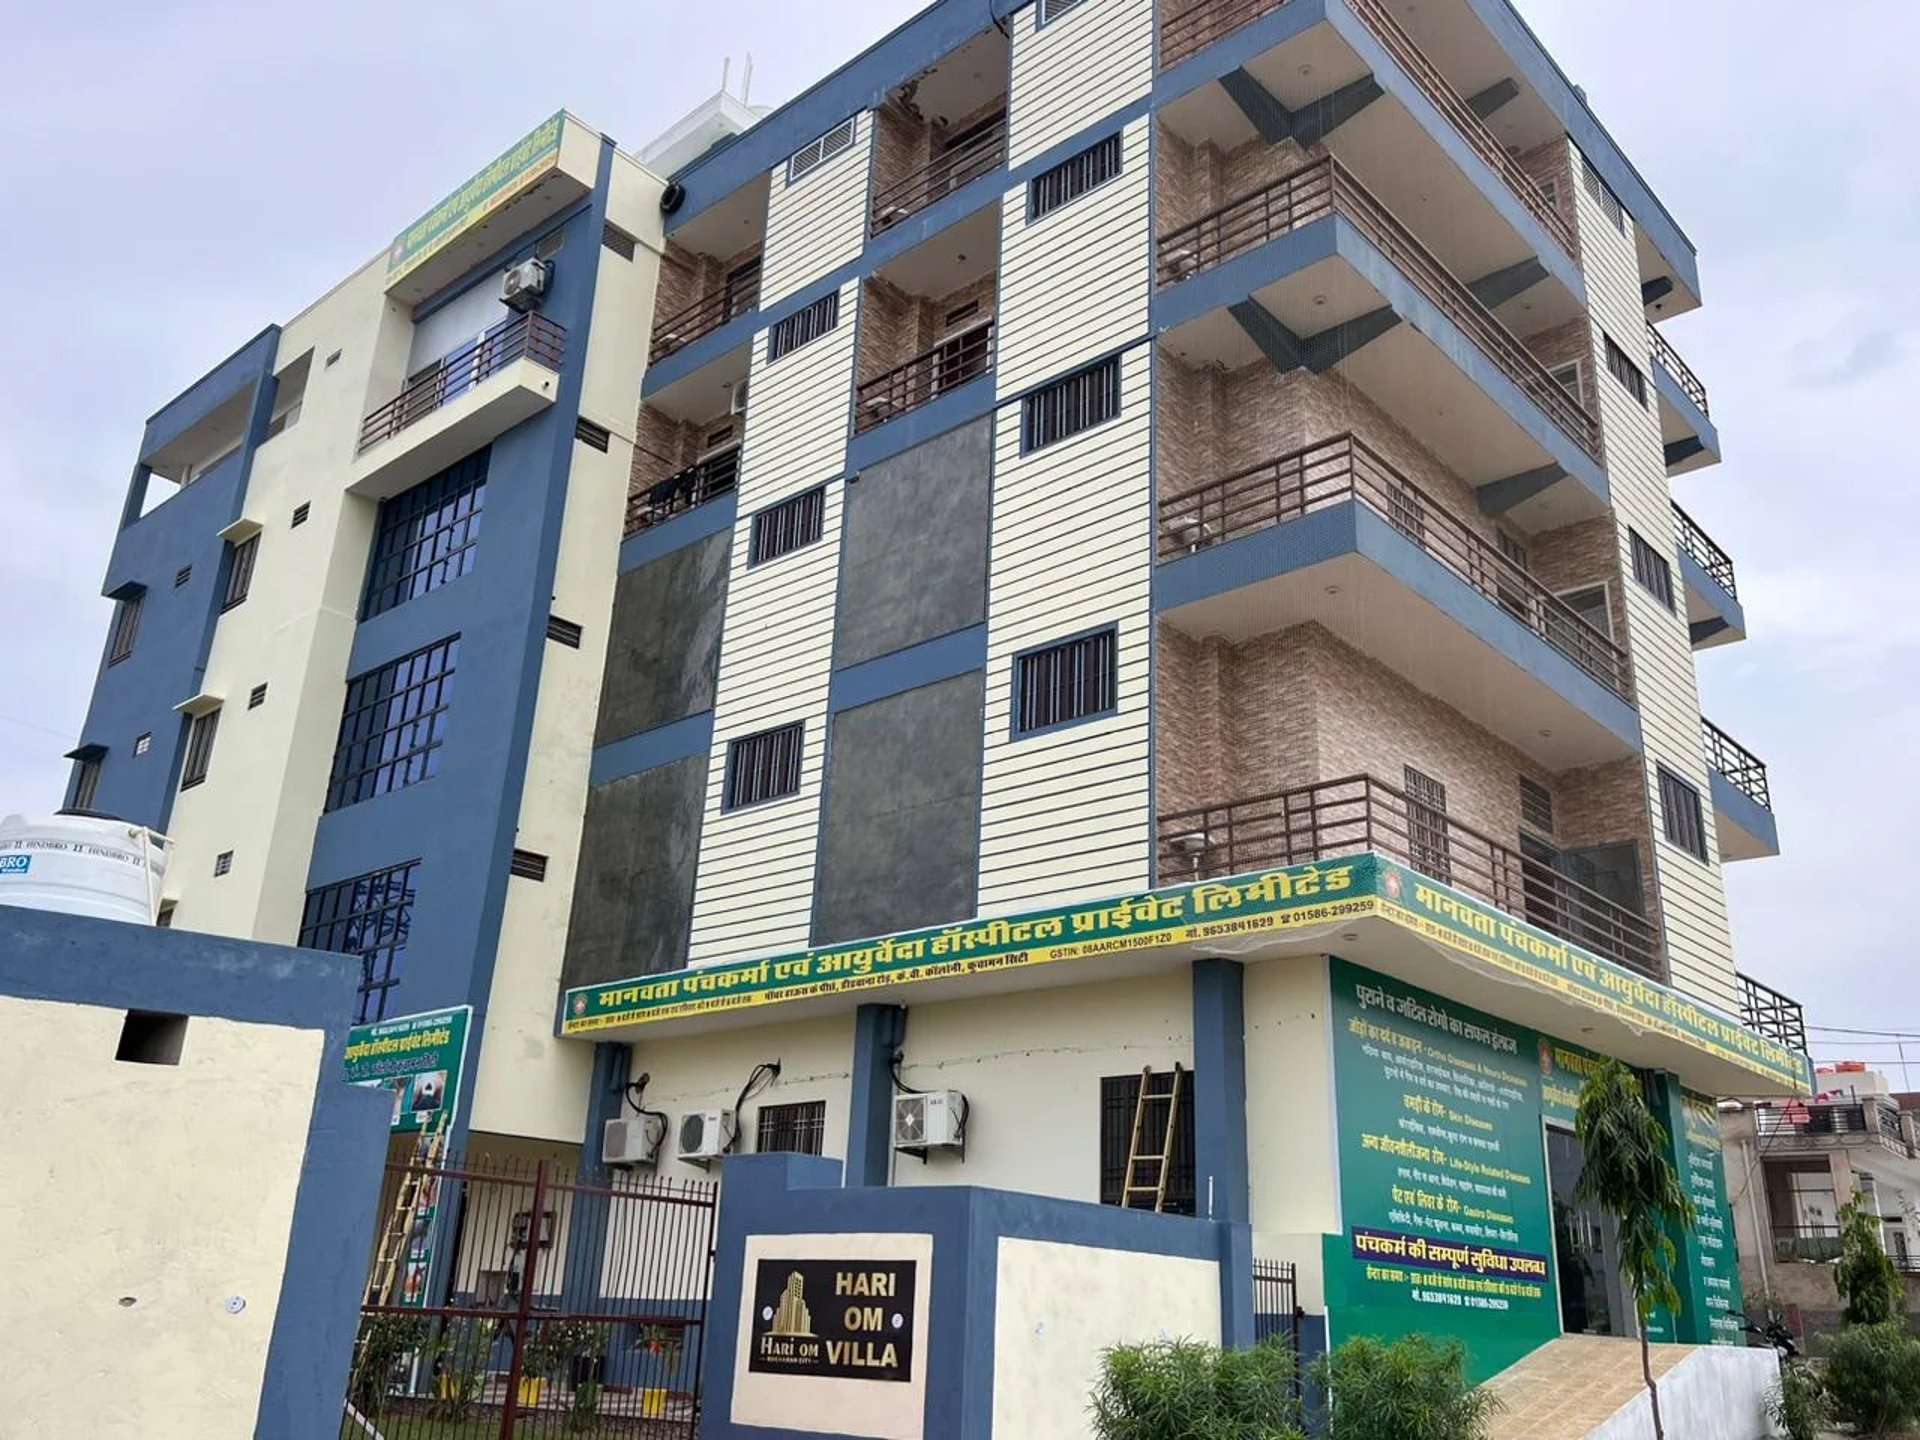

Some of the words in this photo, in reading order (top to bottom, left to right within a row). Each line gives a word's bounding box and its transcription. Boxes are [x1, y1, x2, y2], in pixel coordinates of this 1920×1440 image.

[1414, 883, 1497, 939] मानवता
[1499, 920, 1568, 970] पंचकर्मा
[1569, 957, 1597, 982] एवं
[599, 979, 681, 1007] मानवता
[683, 960, 772, 994] पंचकर्मा
[772, 952, 814, 980] एवं
[816, 937, 927, 975] आयुर्वेदा
[930, 920, 1066, 956] हॉस्पीटल
[1448, 1016, 1463, 1036] का
[1355, 1230, 1407, 1257] पंचकर्म
[1406, 1238, 1427, 1260] की
[1427, 1244, 1469, 1270] सम्पूर्ण
[1470, 1247, 1508, 1274] सुविधा
[1508, 1256, 1546, 1276] उपलब्ध
[835, 1271, 896, 1297] HARI
[843, 1306, 883, 1331] OM
[826, 1340, 898, 1368] VILLA
